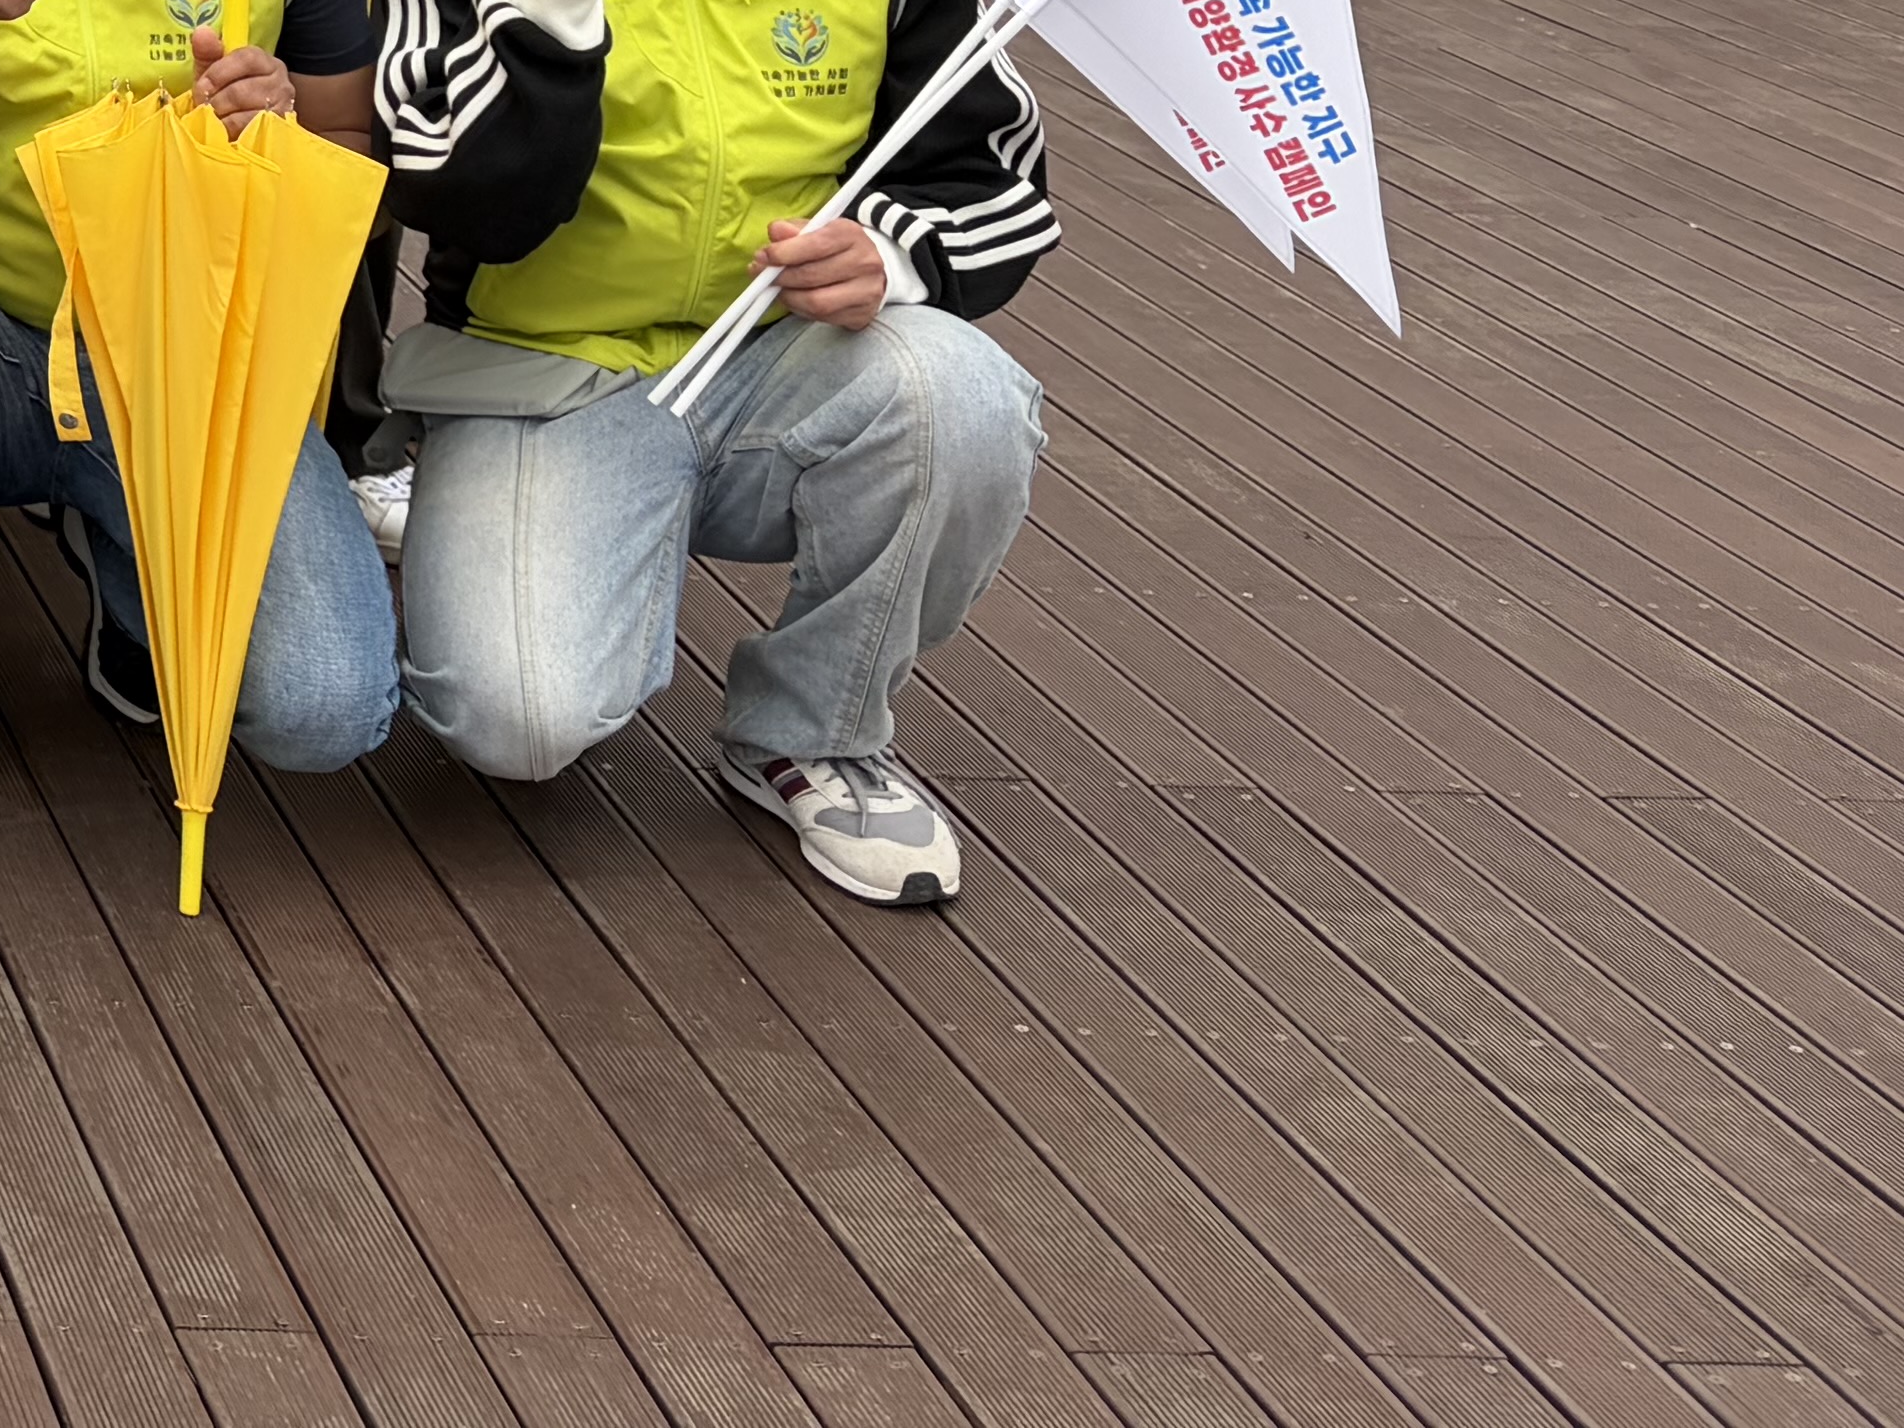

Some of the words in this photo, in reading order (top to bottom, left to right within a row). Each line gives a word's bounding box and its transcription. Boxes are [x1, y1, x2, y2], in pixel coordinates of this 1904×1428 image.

[1235, 84, 1288, 138] 사수
[1263, 136, 1337, 223] 캠페인
[1252, 15, 1326, 107] 가능한
[1301, 104, 1357, 165] 지구
